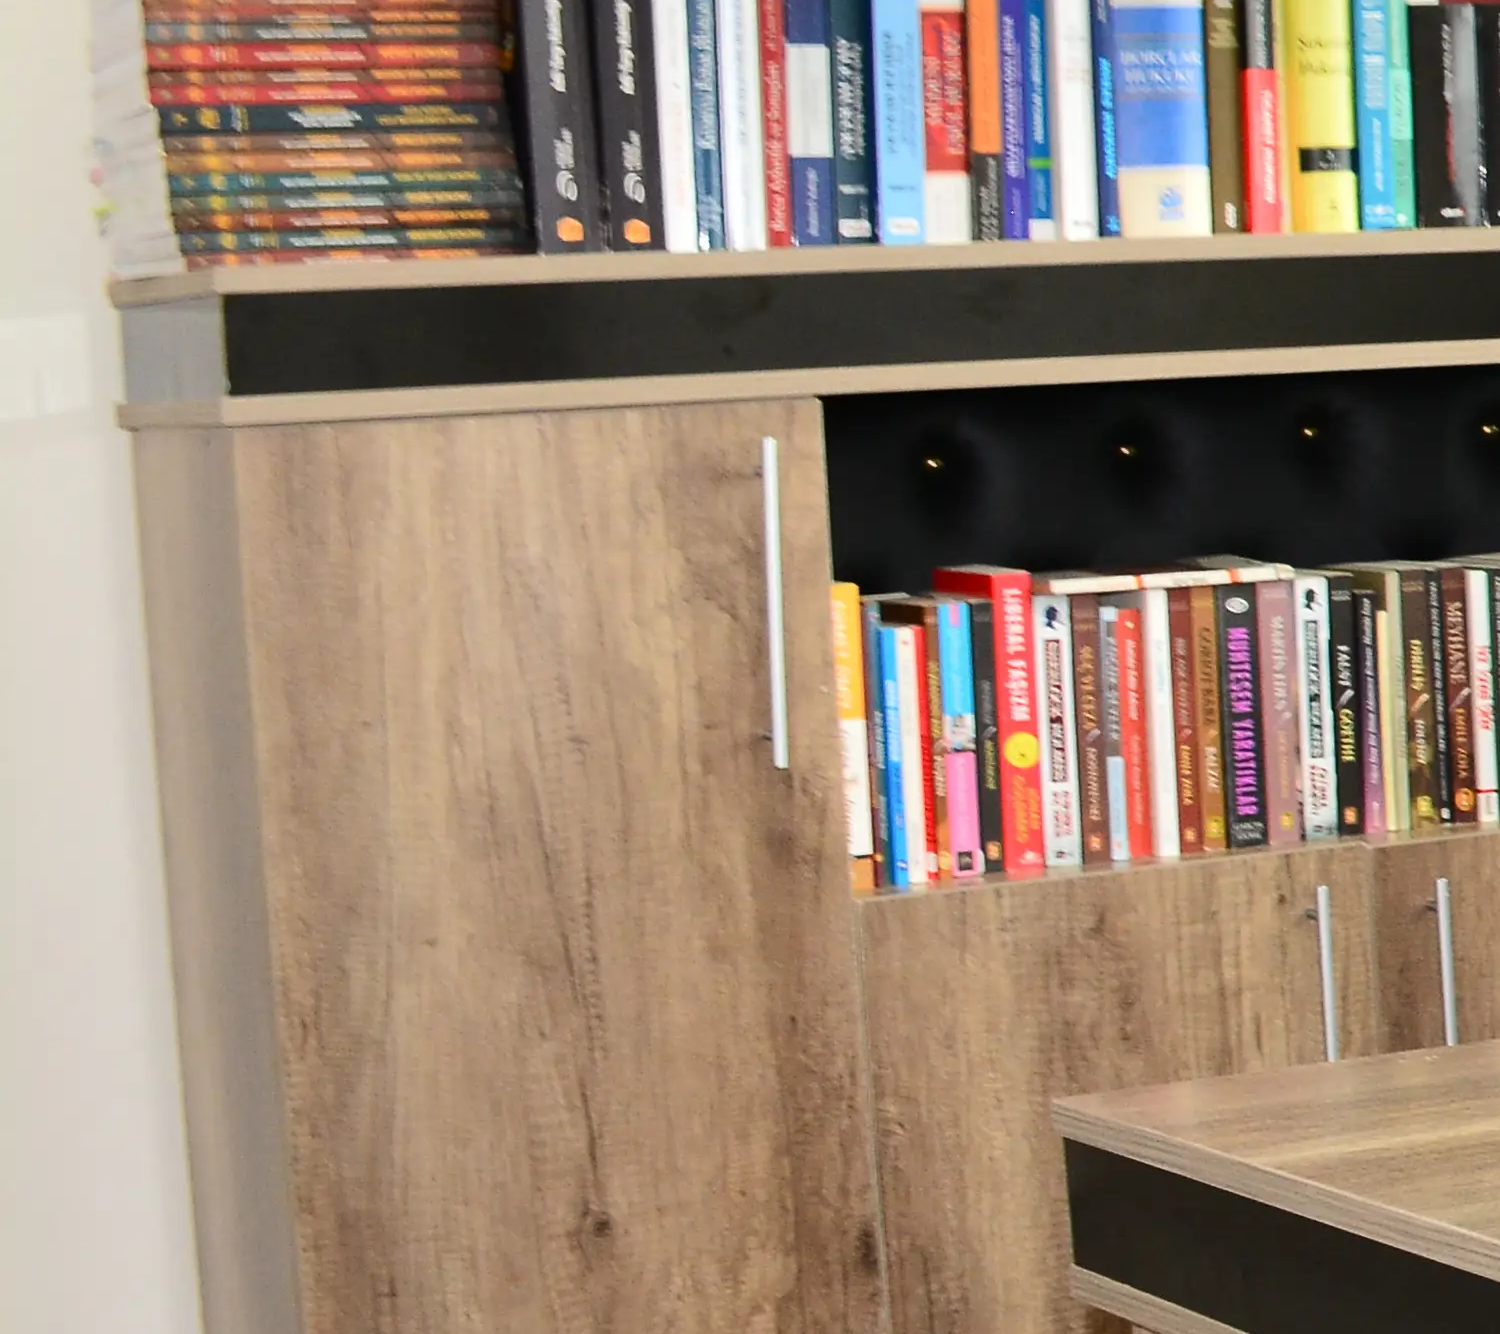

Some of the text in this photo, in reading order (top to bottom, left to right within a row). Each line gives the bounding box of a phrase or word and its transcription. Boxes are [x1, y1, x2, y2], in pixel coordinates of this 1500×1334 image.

[1003, 588, 1030, 721] LİBERAL FAŞİZM
[1336, 645, 1356, 764] FAUST GOETHE
[1445, 601, 1468, 685] MEYHANE
[1457, 747, 1469, 779] ZOLA
[1232, 719, 1259, 816] YARATIKLAR
